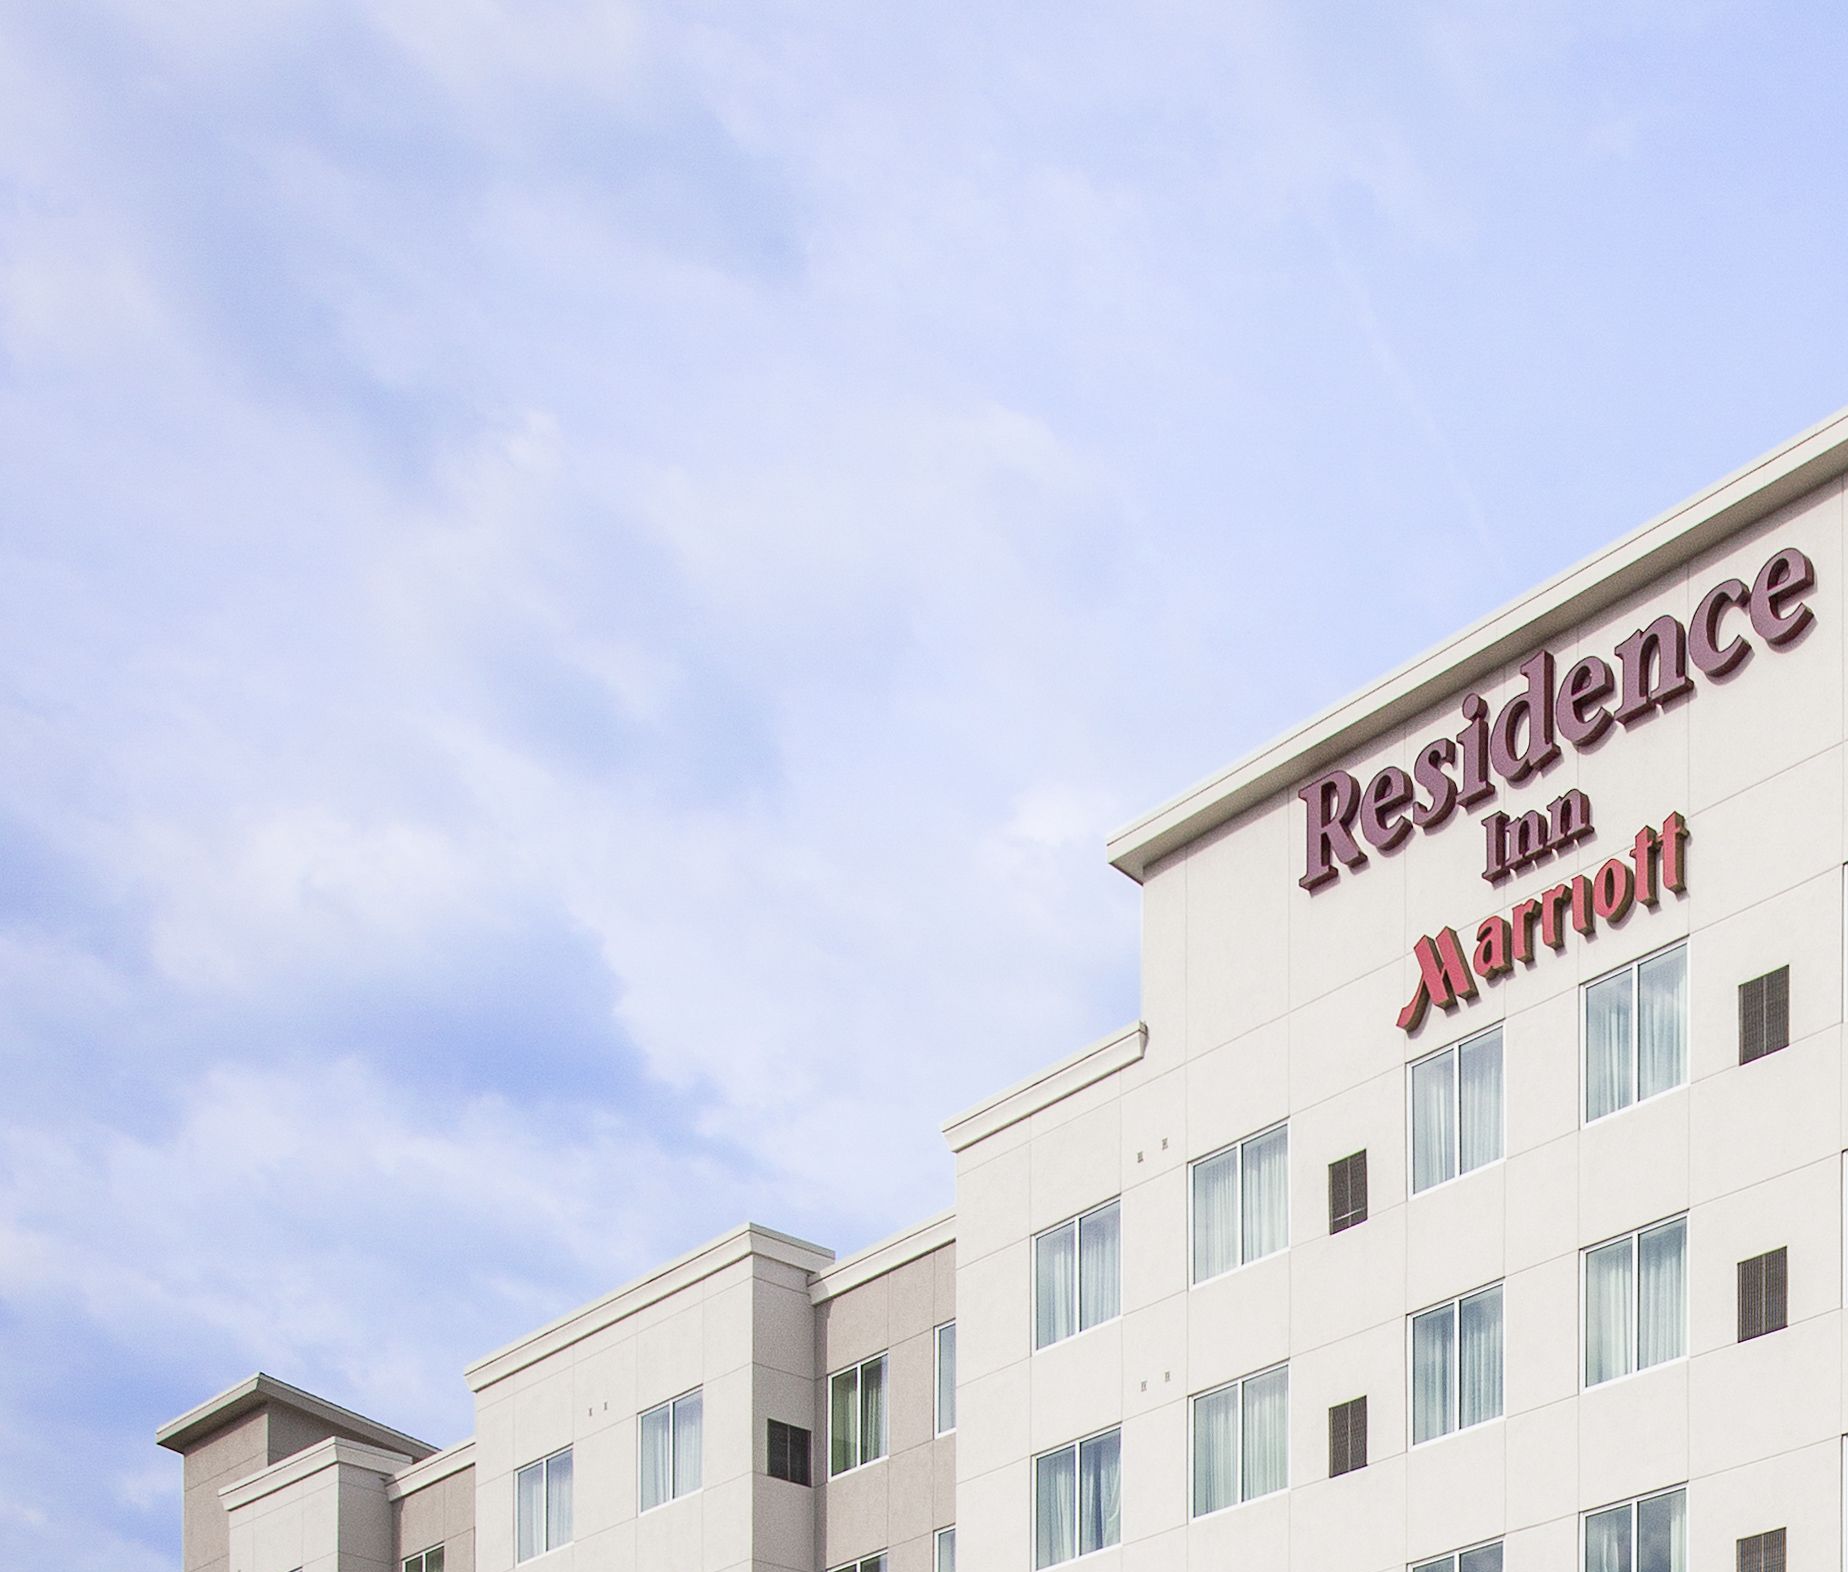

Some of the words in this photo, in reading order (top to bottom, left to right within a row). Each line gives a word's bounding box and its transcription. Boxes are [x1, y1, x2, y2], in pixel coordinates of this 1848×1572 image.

[1298, 547, 1817, 892] Residence
[1396, 811, 1690, 1033] Marriott
[1481, 788, 1595, 883] Inn
